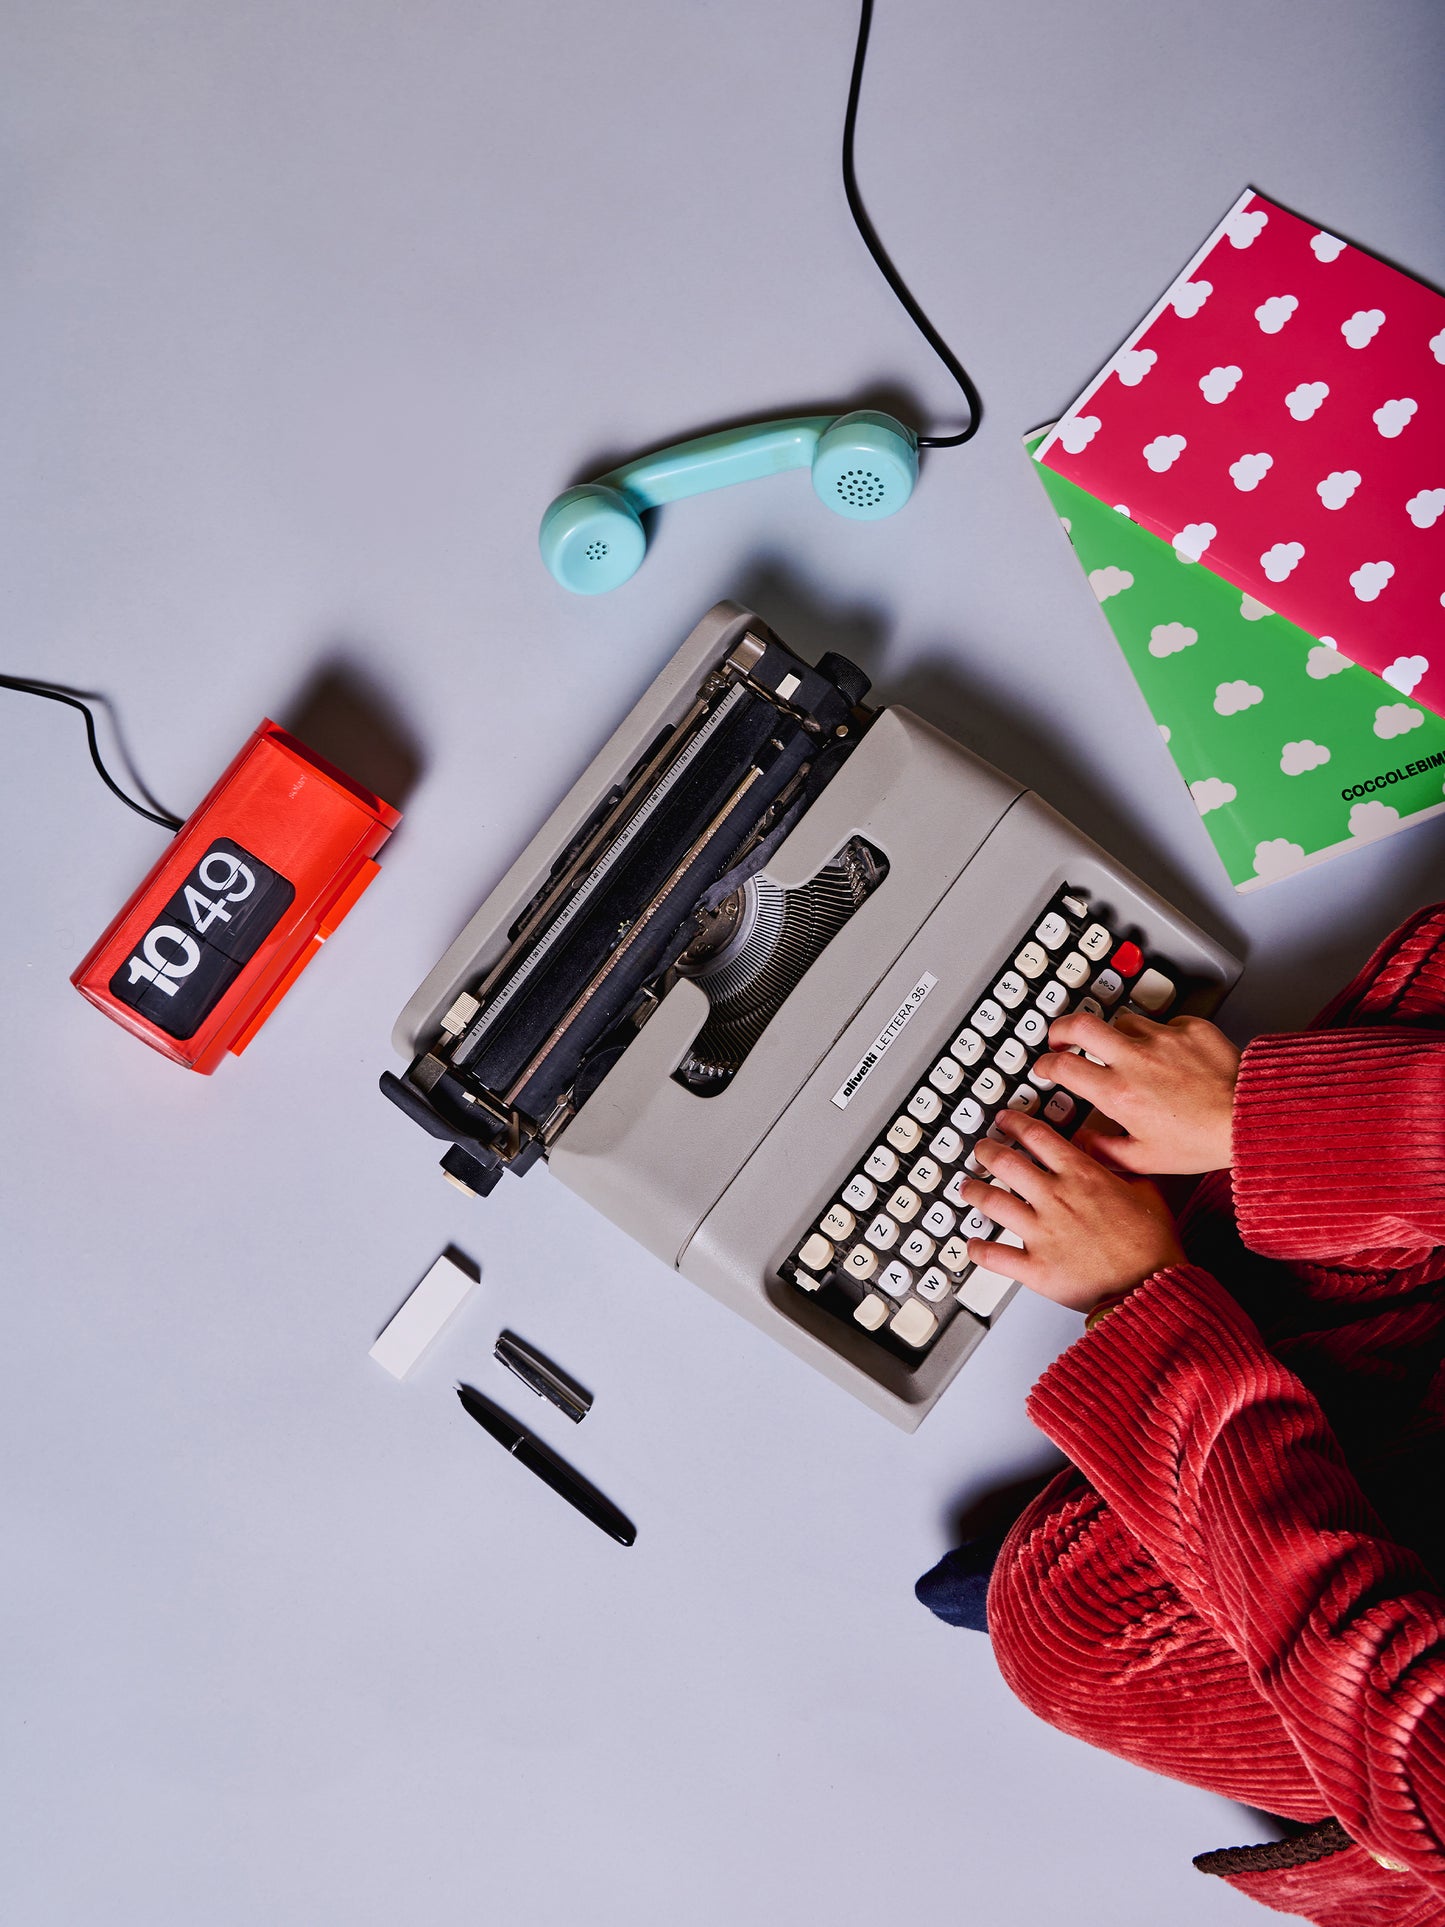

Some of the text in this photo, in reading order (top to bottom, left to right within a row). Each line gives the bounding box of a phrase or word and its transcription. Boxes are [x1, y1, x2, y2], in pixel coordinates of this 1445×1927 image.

[1341, 750, 1445, 801] COCCOLEBIM
[128, 852, 255, 997] 10 49
[1046, 991, 1056, 1003] P
[1025, 1020, 1037, 1031] O
[959, 1038, 967, 1046] 8
[843, 1052, 878, 1097] olivetti
[875, 1003, 914, 1051] LETTERA
[1005, 1050, 1016, 1058] I
[937, 1066, 946, 1074] 7
[981, 1078, 994, 1089] U
[916, 1096, 924, 1104] 6
[1019, 1094, 1029, 1105] J
[960, 1108, 972, 1119] Y
[938, 1137, 950, 1148] T
[873, 1156, 881, 1164] 4
[917, 1167, 931, 1180] R
[896, 1196, 909, 1209] E
[828, 1213, 838, 1223] 2
[931, 1212, 944, 1224] D
[971, 1217, 982, 1229] C
[874, 1223, 887, 1237] Z
[910, 1241, 923, 1253] S
[947, 1246, 961, 1259] X
[853, 1254, 868, 1266] Q
[889, 1272, 901, 1284] A
[925, 1275, 939, 1290] W
